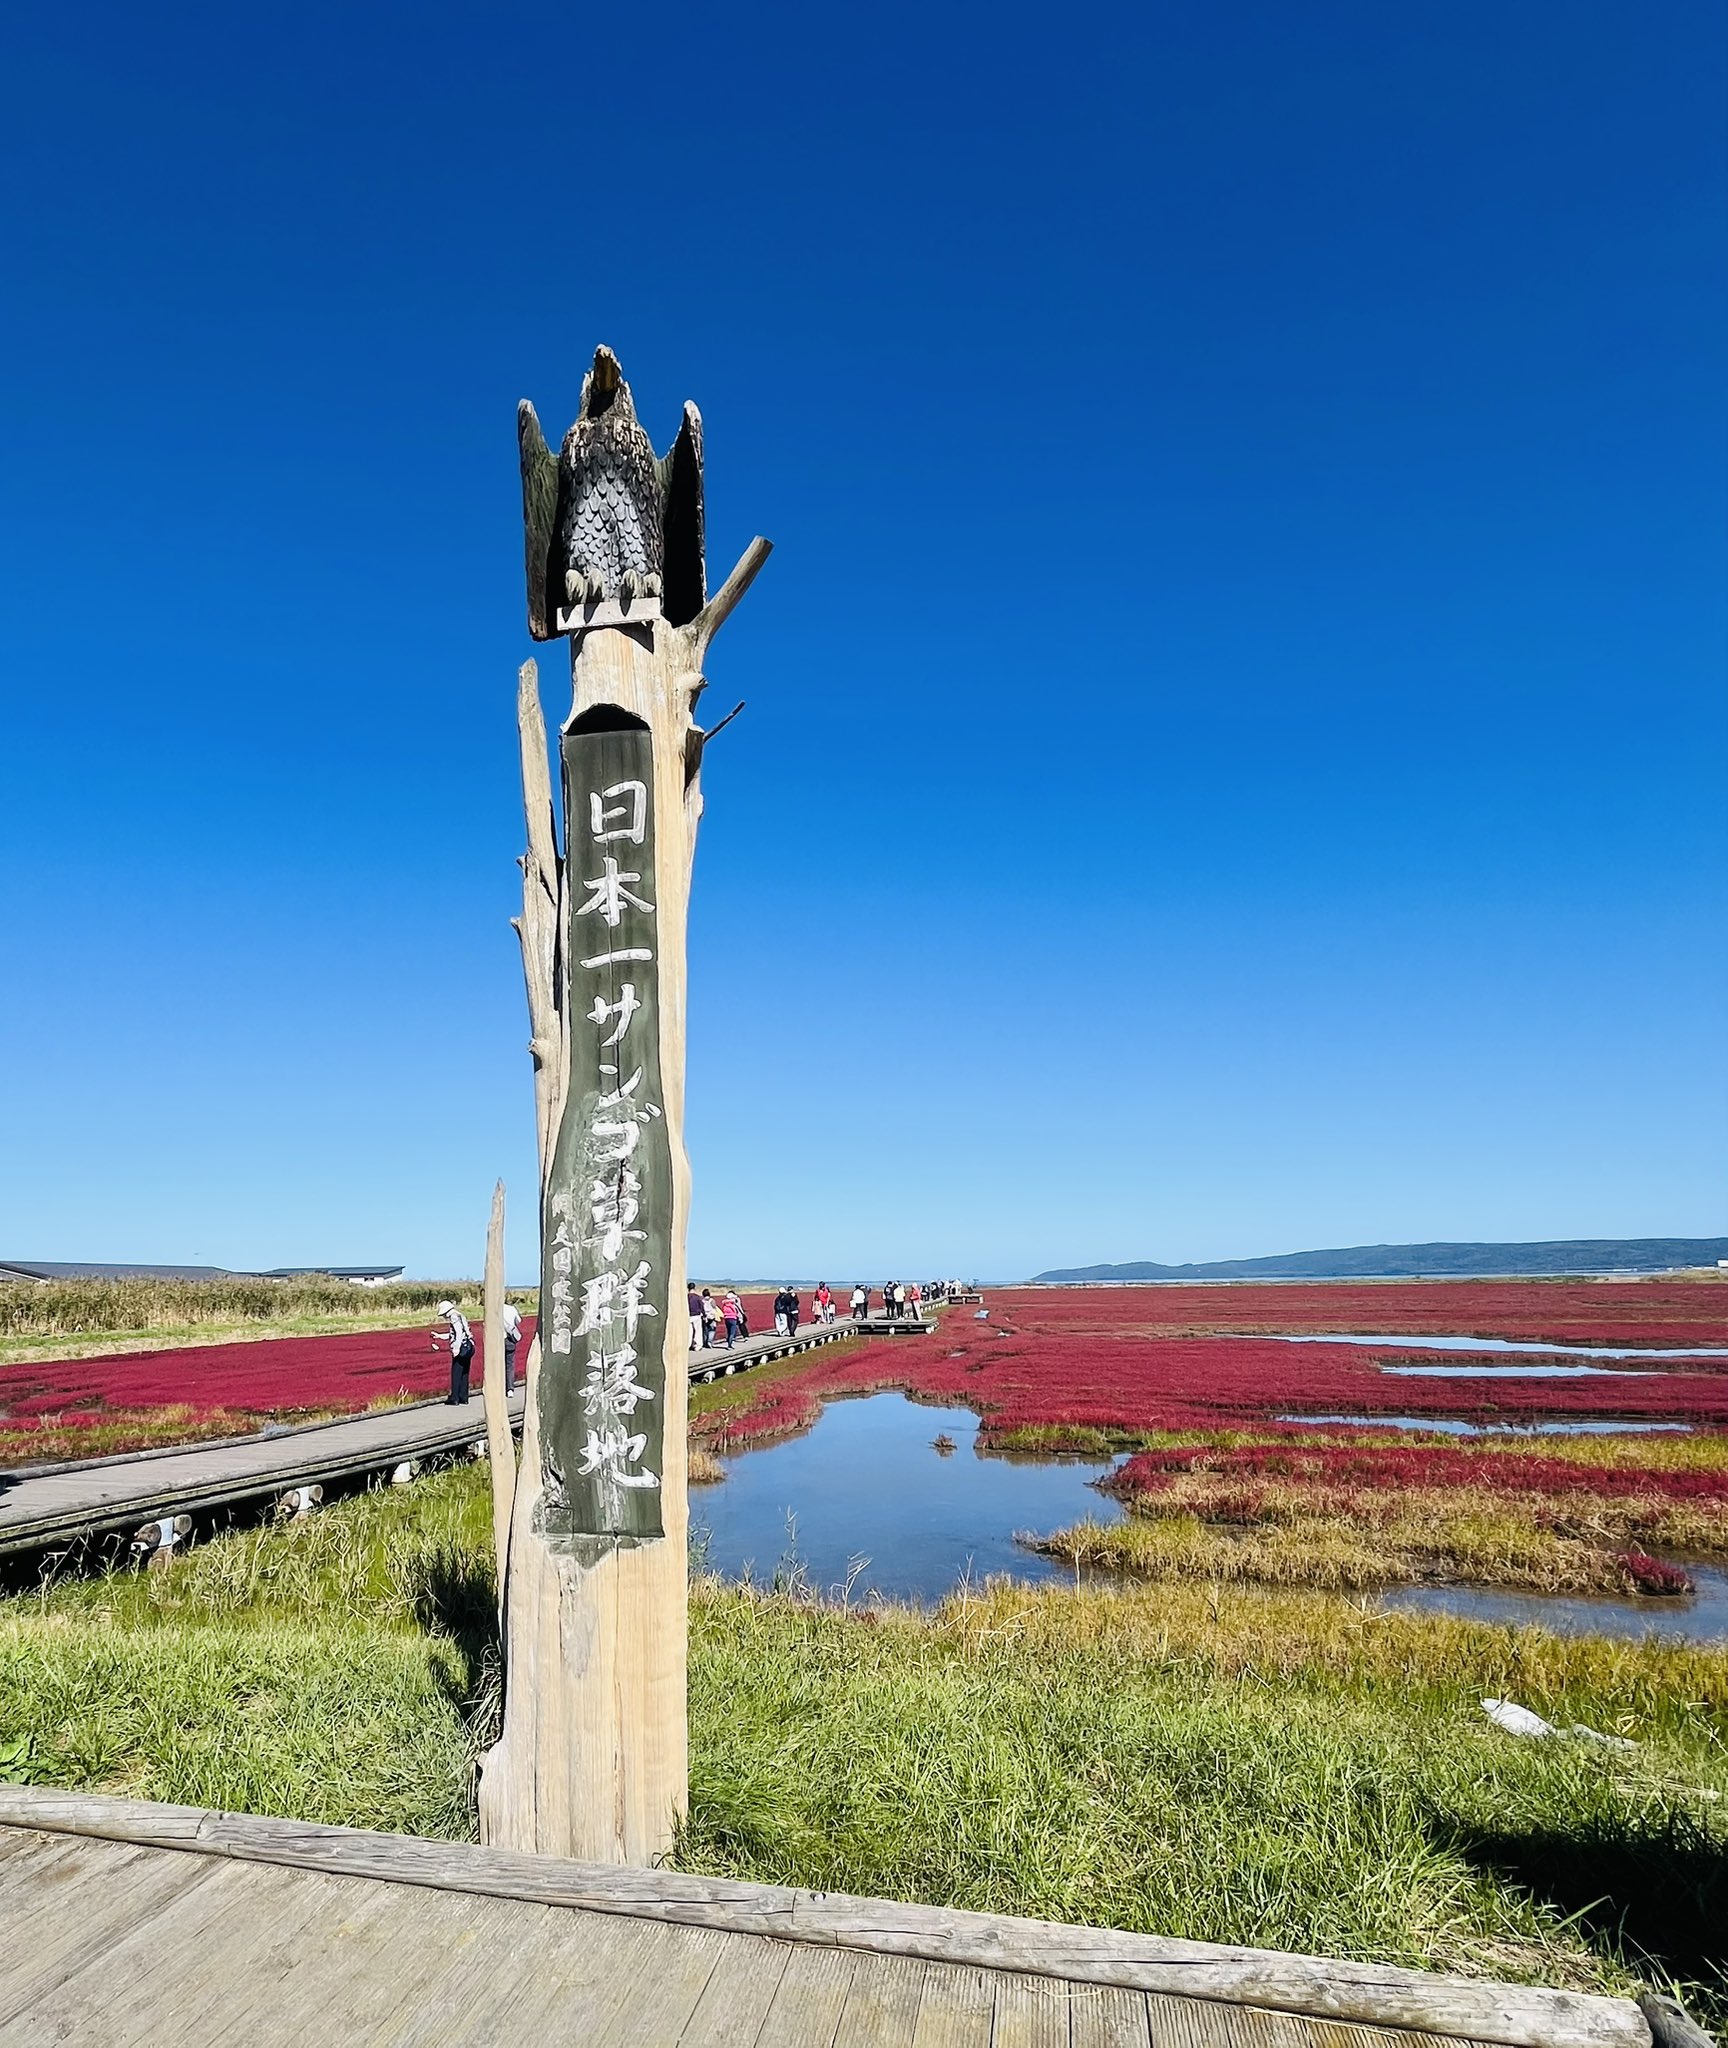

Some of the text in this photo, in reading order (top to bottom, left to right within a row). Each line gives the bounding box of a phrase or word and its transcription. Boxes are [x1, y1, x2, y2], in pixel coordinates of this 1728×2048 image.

[573, 779, 662, 1489] 日本一サンゴ草群落地
